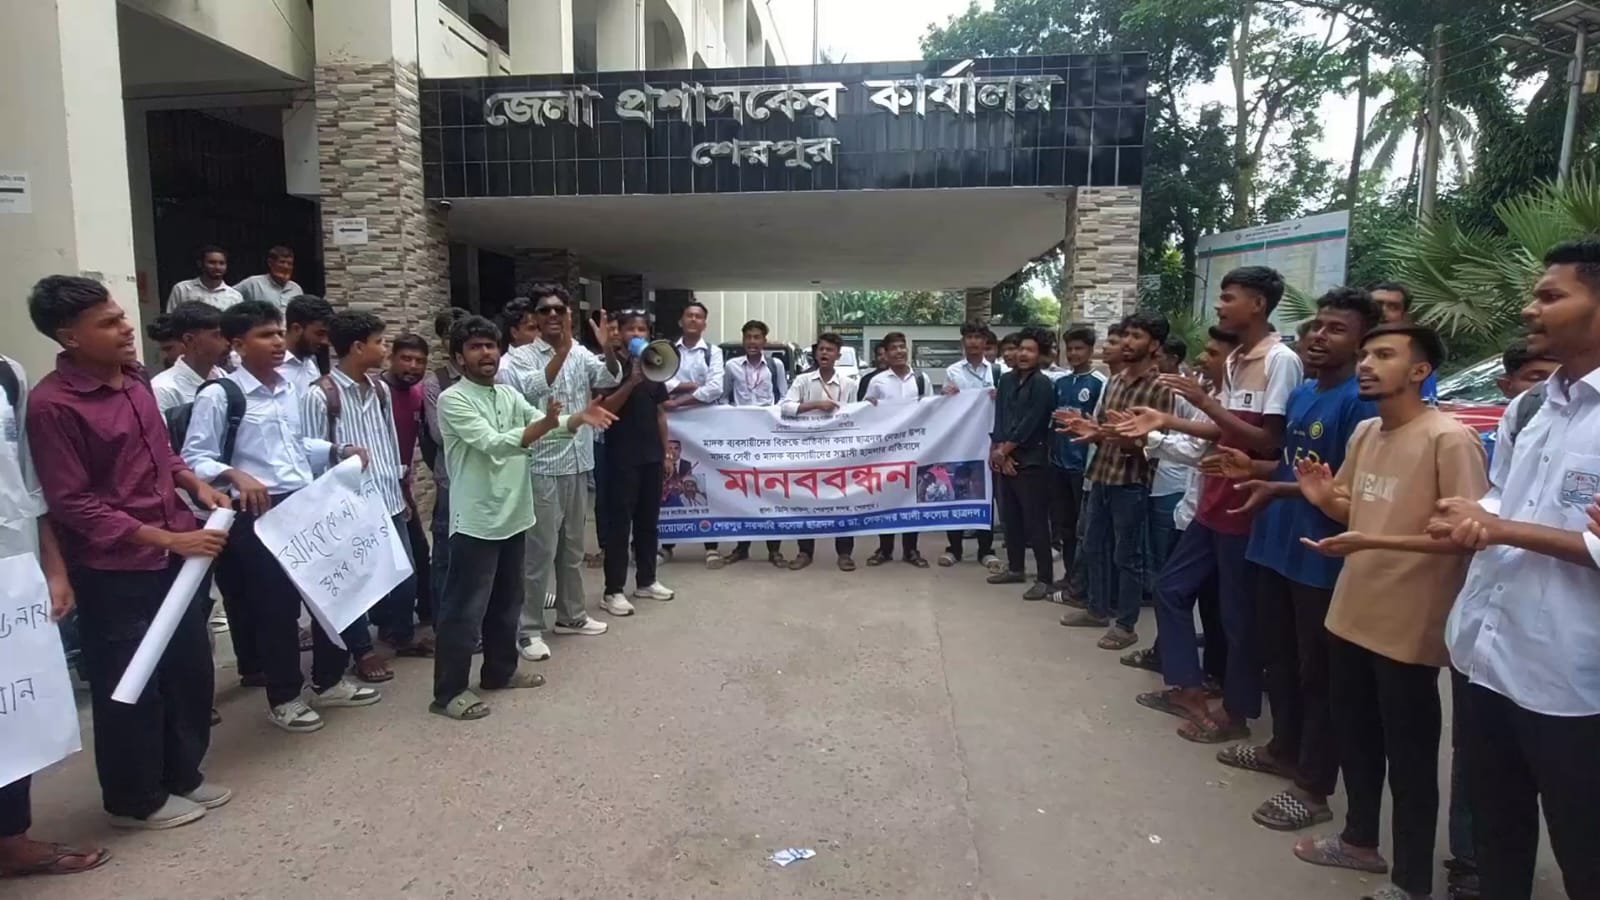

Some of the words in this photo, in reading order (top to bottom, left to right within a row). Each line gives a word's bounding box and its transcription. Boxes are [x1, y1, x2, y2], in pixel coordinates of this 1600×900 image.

[484, 85, 603, 128] জেলা
[615, 81, 848, 129] প্রশাসকের
[863, 59, 1066, 120] কার্যালয়
[691, 137, 841, 169] শেরপুর
[703, 438, 724, 447] মাদক
[726, 436, 771, 448] ব্যবসায়ীদের
[773, 436, 799, 447] বিরুদ্ধে
[802, 435, 830, 446] প্রতিবাদ
[856, 434, 882, 444] ছাত্রদল
[710, 452, 731, 461] মাদক
[733, 450, 751, 461] সেবী
[754, 453, 761, 461] ও
[763, 452, 784, 461] মাদক
[786, 450, 831, 460] ব্যবসায়ীদের
[717, 460, 918, 499] মানববন্ধন
[713, 521, 742, 533] শেরপুর
[744, 519, 775, 530] সরকারি
[778, 520, 804, 530] কলেজ
[806, 520, 835, 529] ছাত্রদল
[838, 520, 845, 528] ও
[900, 509, 921, 521] আলী
[923, 509, 949, 520] কলেজ
